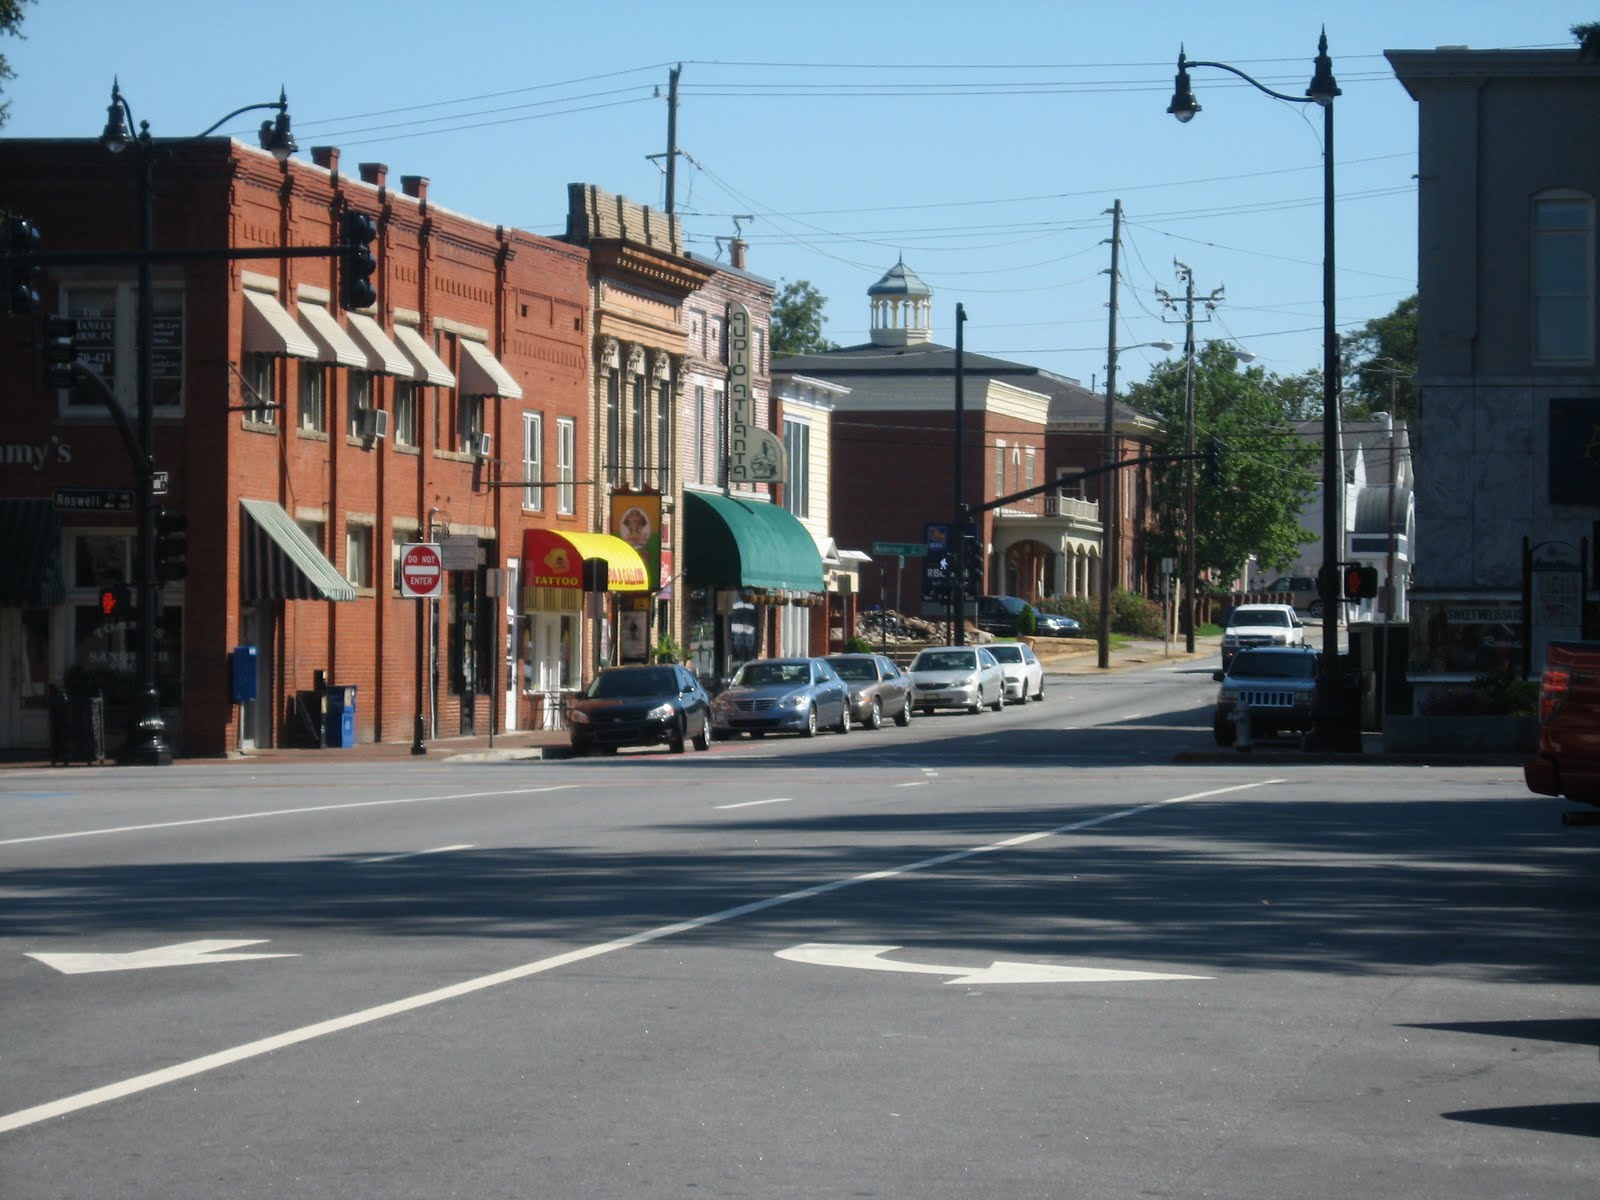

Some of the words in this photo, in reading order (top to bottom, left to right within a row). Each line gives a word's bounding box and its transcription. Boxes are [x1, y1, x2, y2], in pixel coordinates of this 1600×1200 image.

[733, 311, 746, 376] AUDIO
[733, 383, 746, 479] ATLANTA
[56, 493, 100, 507] Roswell
[407, 555, 418, 564] DO
[421, 555, 436, 564] NOT
[410, 576, 433, 585] ENTER
[535, 576, 578, 586] TATTOO
